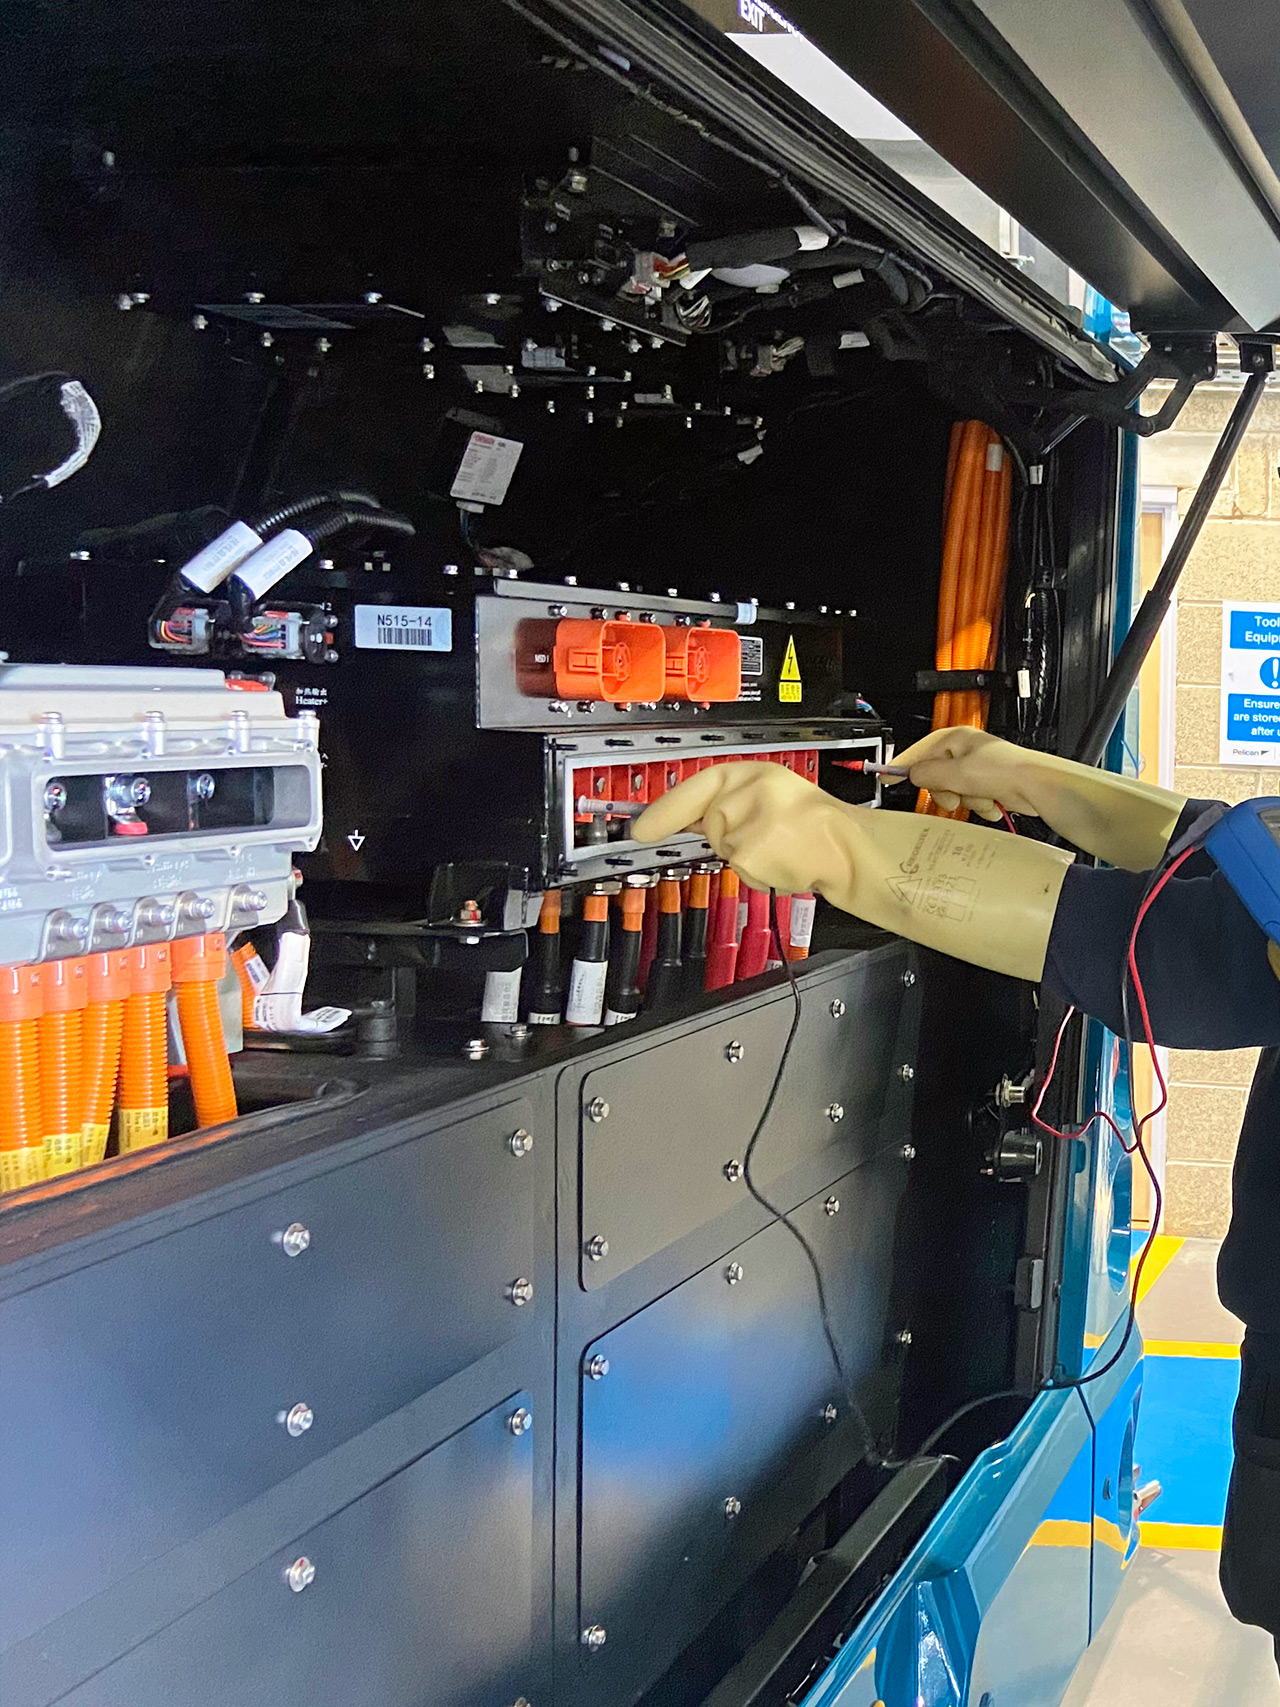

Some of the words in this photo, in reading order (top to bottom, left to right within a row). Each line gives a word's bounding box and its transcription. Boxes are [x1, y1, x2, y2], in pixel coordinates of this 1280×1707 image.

[377, 614, 432, 627] N515-14
[1244, 699, 1280, 709] Ensure
[1233, 714, 1249, 722] are
[1251, 726, 1274, 736] after
[1232, 748, 1259, 756] Pelican
